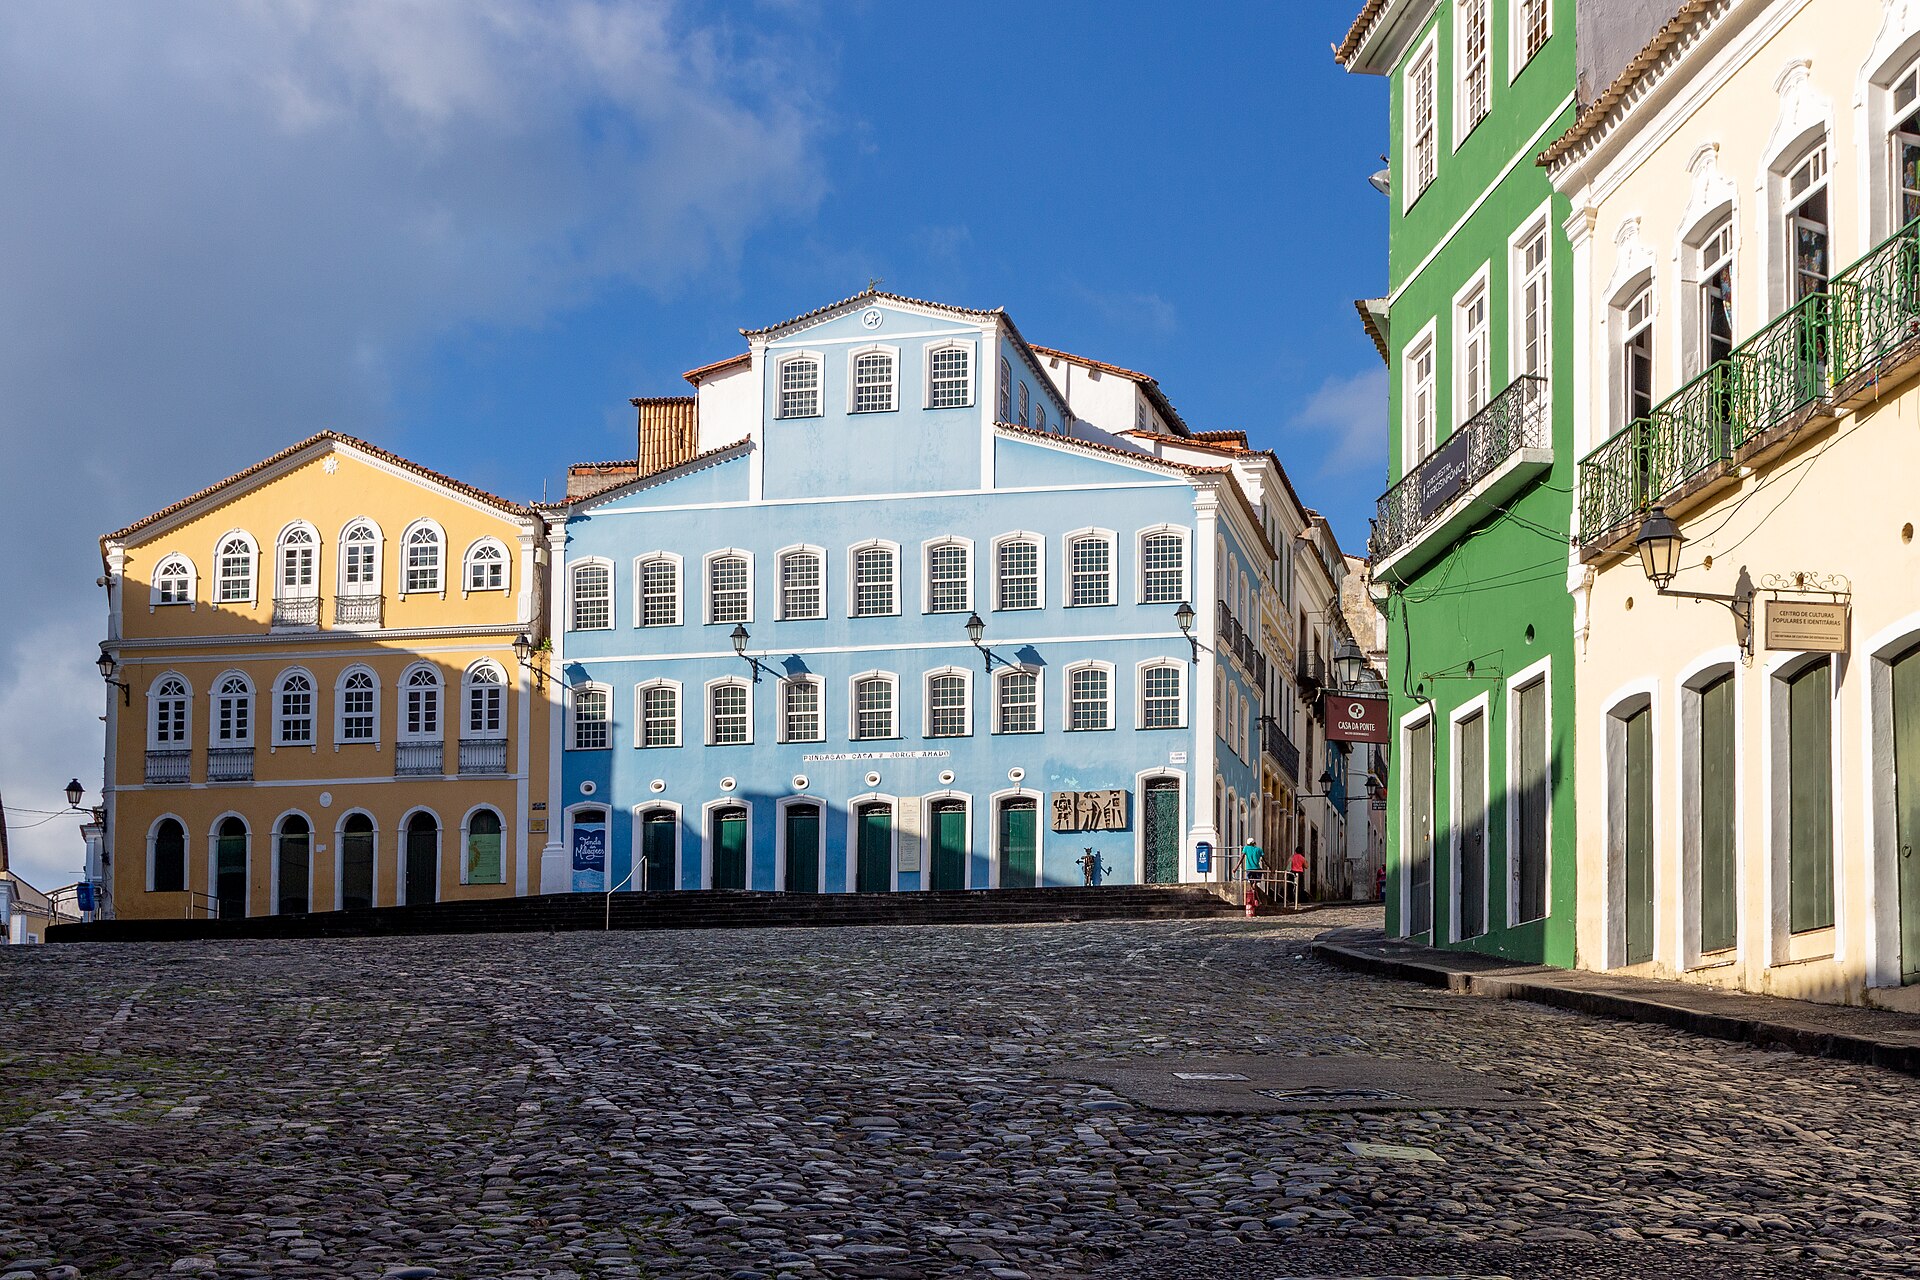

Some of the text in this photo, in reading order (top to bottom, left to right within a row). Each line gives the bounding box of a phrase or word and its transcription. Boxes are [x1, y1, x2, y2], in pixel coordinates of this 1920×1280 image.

[1772, 617, 1802, 625] POPULARES
[1807, 618, 1841, 626] IDENTITÁRIAS
[1337, 721, 1376, 732] CASA DA PONTE
[922, 750, 949, 758] AMADO
[579, 836, 602, 847] Tenda
